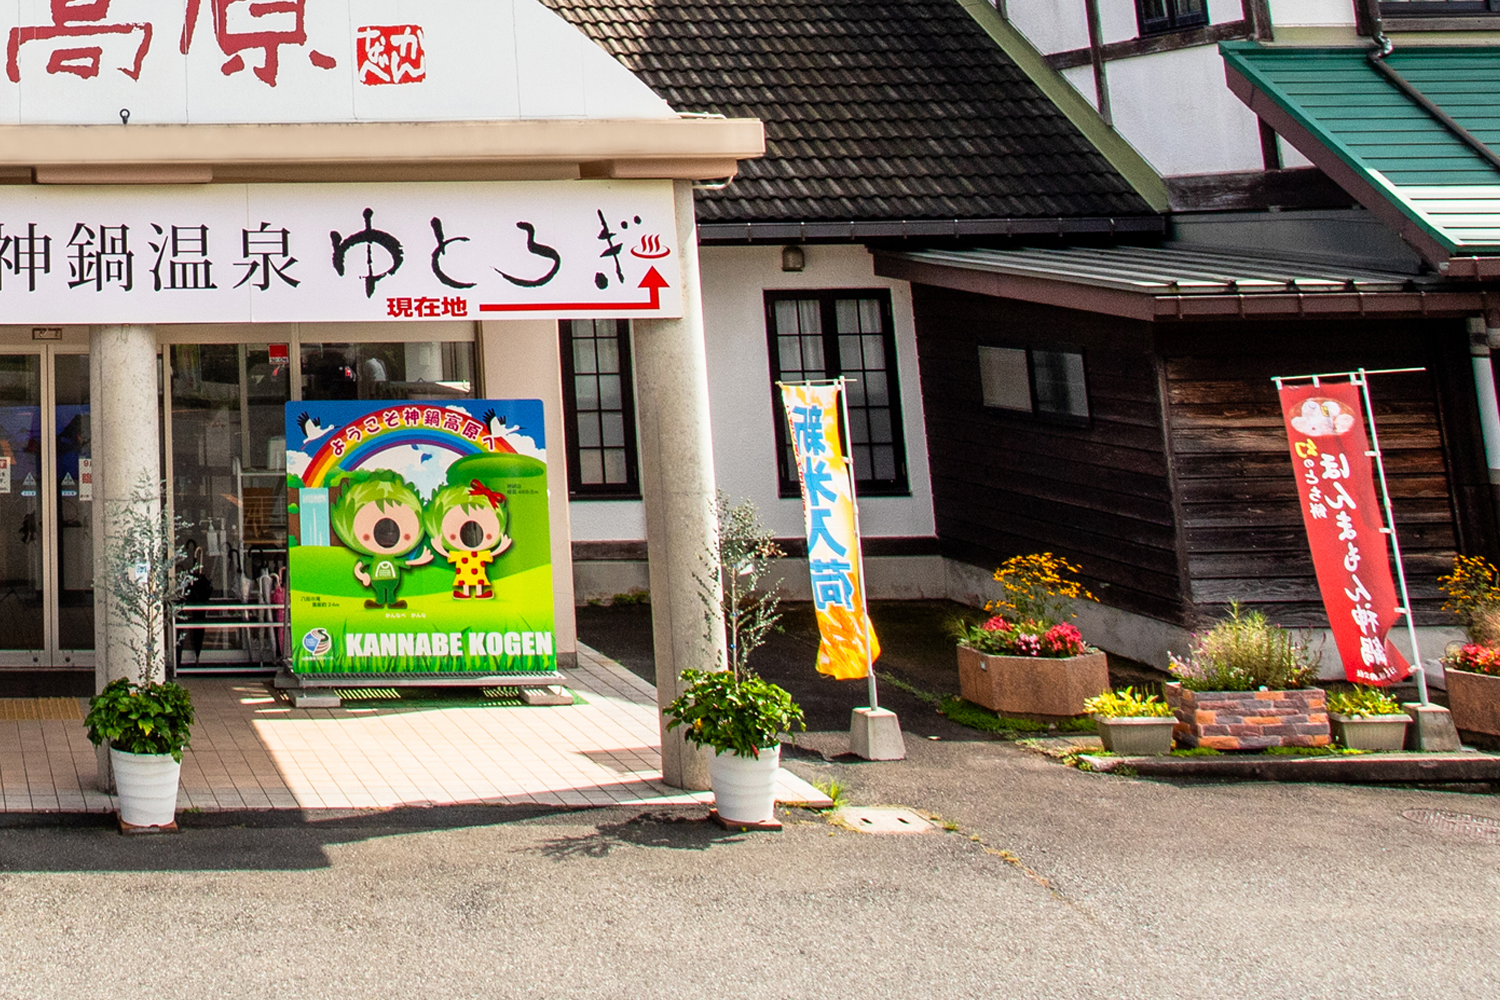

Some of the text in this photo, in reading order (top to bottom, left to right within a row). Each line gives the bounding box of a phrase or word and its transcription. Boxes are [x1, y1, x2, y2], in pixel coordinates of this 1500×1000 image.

[330, 206, 643, 298] ゆとろぎ
[386, 296, 468, 318] 現在地
[330, 408, 495, 456] ようこそ神鍋高原へ
[345, 631, 552, 657] KANNABE KOGEN
